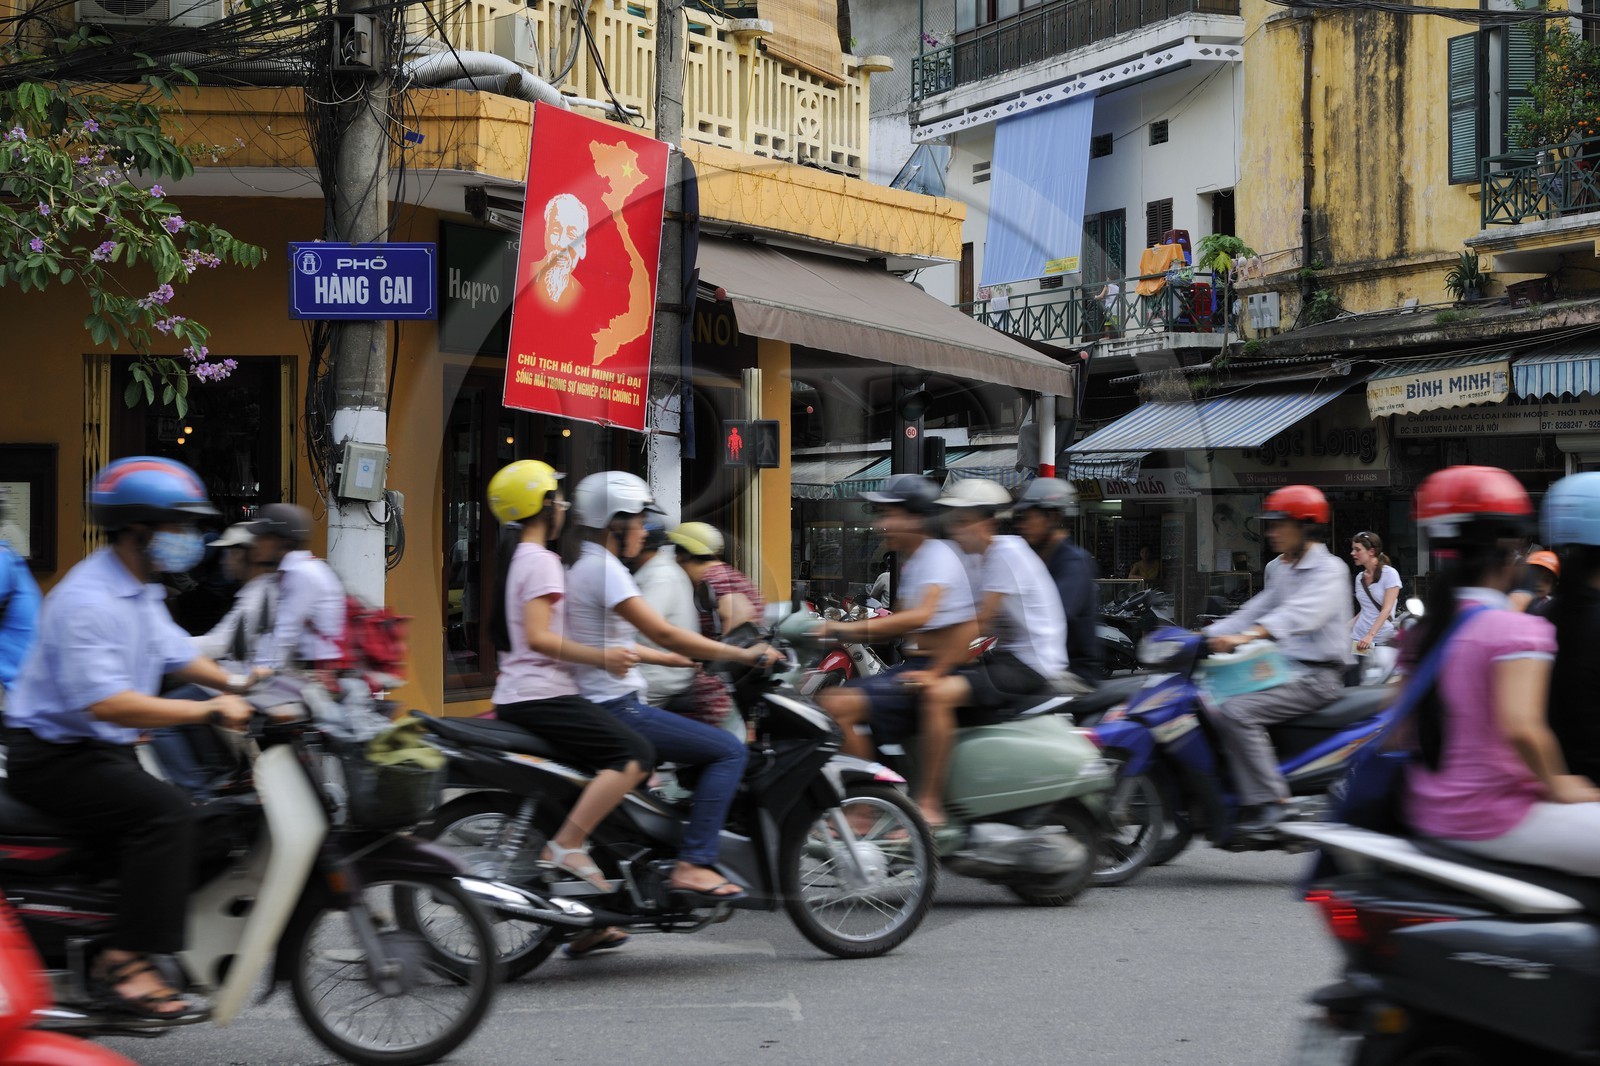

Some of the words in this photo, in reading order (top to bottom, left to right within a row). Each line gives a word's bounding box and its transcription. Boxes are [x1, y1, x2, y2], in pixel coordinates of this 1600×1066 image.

[315, 272, 369, 304] HÀNG
[380, 275, 412, 304] GAI
[449, 267, 500, 309] Hapro
[517, 352, 537, 366] CHỦ
[538, 357, 559, 371] TỊCH
[560, 360, 573, 374] HỒ
[574, 364, 590, 378] CHÍ
[592, 368, 615, 383] MINH
[617, 372, 626, 384] VĨ
[627, 375, 642, 390] ĐẠI
[1406, 379, 1443, 400] BÌNH
[1449, 371, 1491, 393] MINH
[515, 366, 533, 386] SỐNG
[533, 372, 546, 388] MÃI
[547, 375, 567, 392] TRONG
[576, 381, 599, 400] NGHIỆP
[599, 382, 612, 401] CỦA
[612, 388, 632, 405] CHÚNG
[632, 394, 640, 407] TA
[1408, 414, 1441, 423] CHUYÊN
[1502, 410, 1521, 419] KÍNH
[1523, 410, 1549, 418] MODE
[1475, 422, 1485, 432] HÀ
[1486, 422, 1499, 433] NỘI
[907, 428, 916, 437] 60
[1242, 430, 1306, 467] gọc
[1310, 419, 1377, 464] Long
[1106, 481, 1131, 495] ANH
